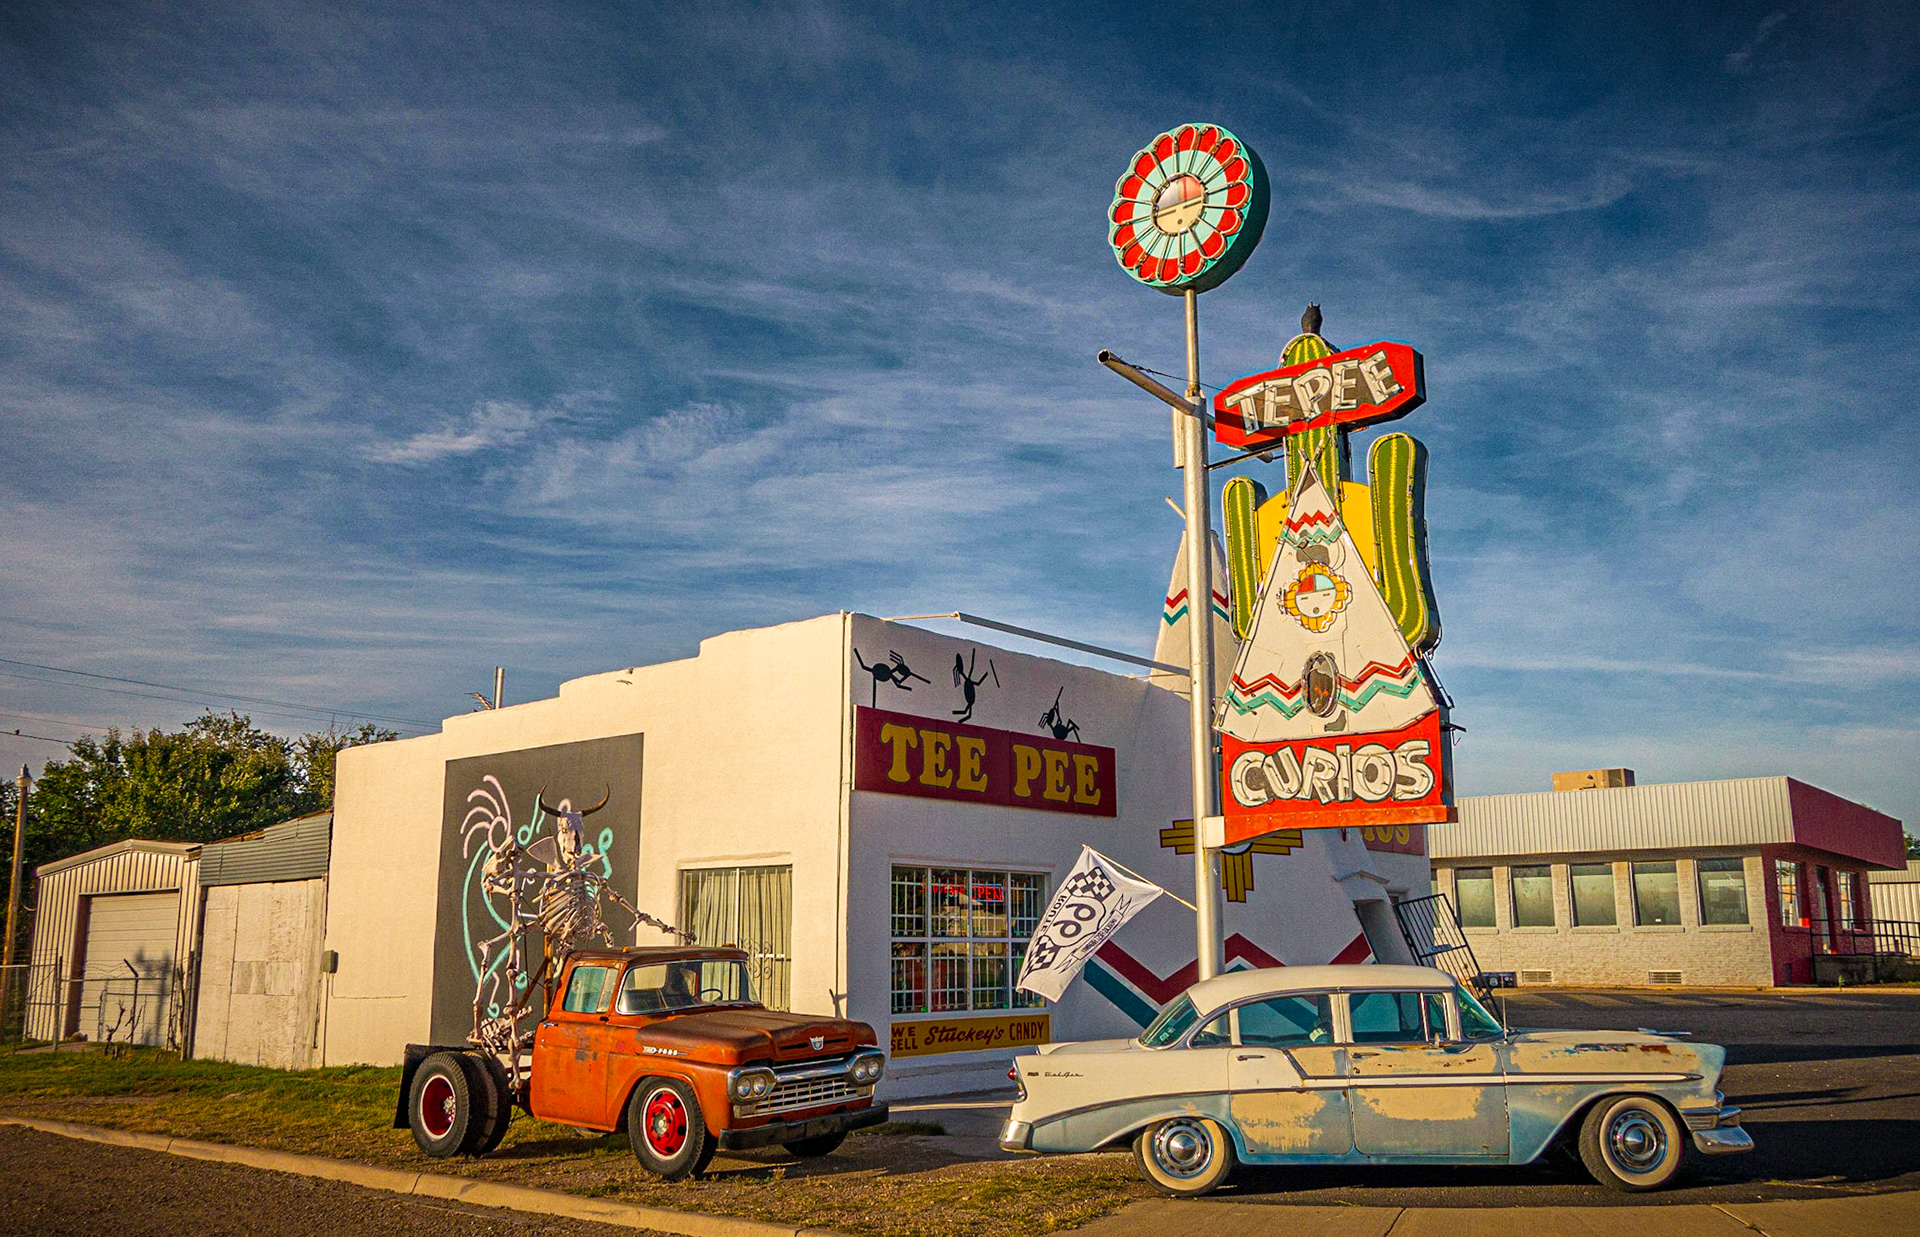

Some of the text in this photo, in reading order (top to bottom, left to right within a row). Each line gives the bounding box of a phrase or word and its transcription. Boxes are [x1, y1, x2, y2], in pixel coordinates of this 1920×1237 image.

[1224, 350, 1402, 436] TEPEE
[880, 722, 1101, 806] TEE PEE
[1230, 738, 1436, 807] CURIOS
[970, 885, 1003, 901] OPEN
[890, 1037, 918, 1052] SELL
[891, 1026, 916, 1038] WE
[924, 1021, 1045, 1046] Stuckey's CANDY
